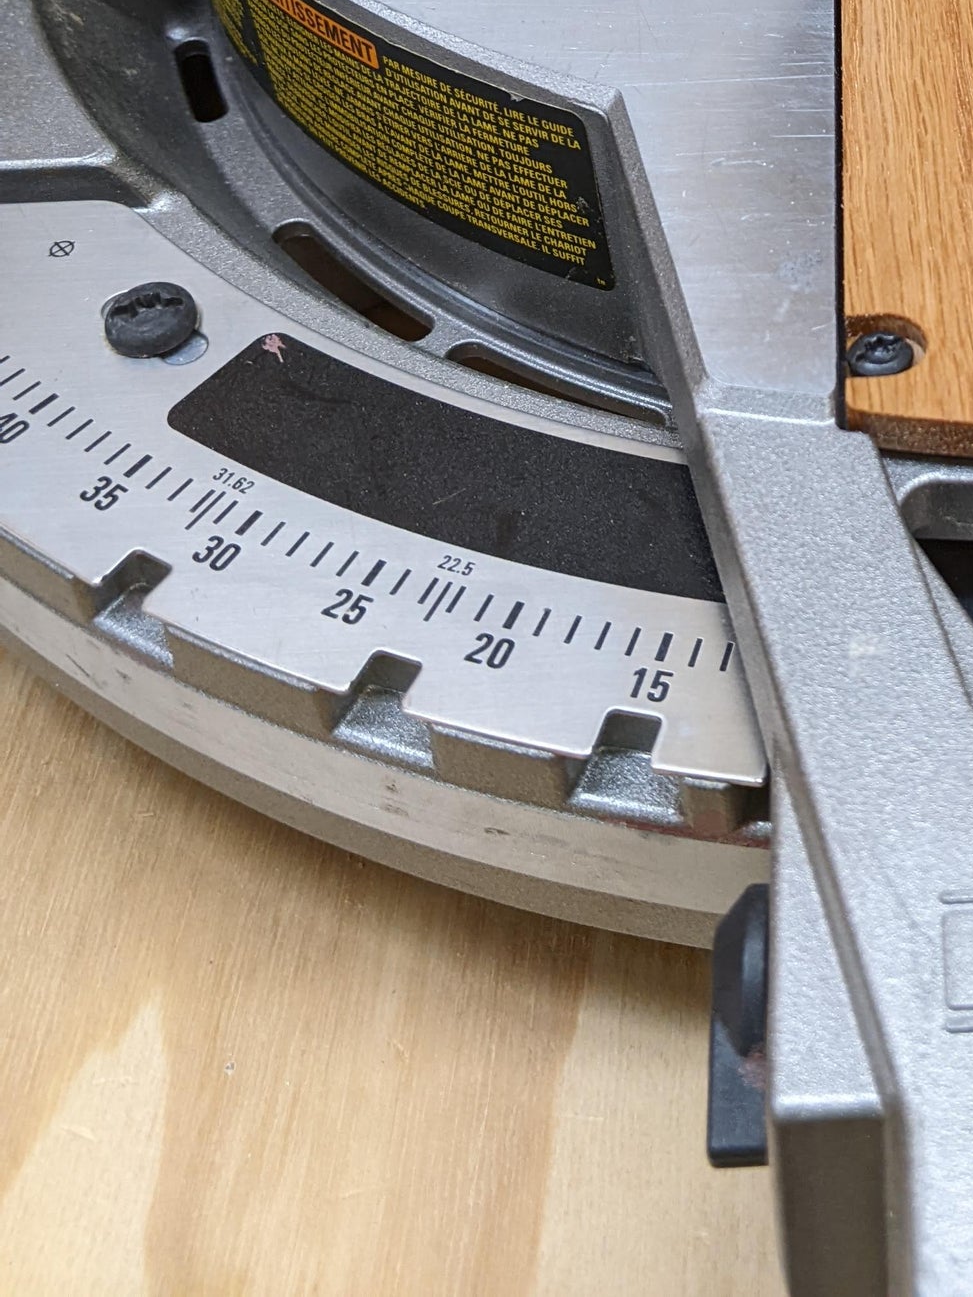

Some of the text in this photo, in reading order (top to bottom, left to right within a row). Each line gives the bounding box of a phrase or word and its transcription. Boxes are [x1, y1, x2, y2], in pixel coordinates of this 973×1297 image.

[382, 56, 400, 69] PAR
[401, 65, 438, 87] MESURE
[440, 83, 452, 93] DE
[503, 107, 525, 121] LIRE
[526, 115, 539, 126] LE
[541, 120, 574, 136] GUIDE
[384, 68, 581, 149] D'UTILISATION AVANT DE SE SERVIR DE LA
[384, 77, 440, 110] TRAJECTOIRE
[443, 107, 455, 116] DE
[457, 112, 470, 122] LA
[502, 130, 516, 140] NE
[518, 135, 539, 148] PAS
[401, 107, 436, 128] CHAQUE
[498, 149, 552, 173] TOUJOURS
[458, 123, 470, 132] LA
[472, 129, 530, 154] FERMETURE
[418, 145, 430, 154] DE
[431, 151, 443, 160] LA
[472, 170, 510, 189] METTRE
[512, 185, 548, 202] L'OUTIL
[550, 198, 577, 212] HORS
[434, 163, 446, 171] DE
[448, 169, 460, 178] LA
[461, 175, 487, 189] LAME
[489, 186, 520, 203] AVANT
[522, 198, 536, 209] DE
[476, 151, 490, 160] NE
[491, 156, 510, 169] PAS
[512, 164, 568, 188] EFFECTUER
[480, 163, 492, 172] DE
[494, 168, 506, 178] LA
[508, 173, 536, 188] LAME
[537, 183, 551, 193] DE
[553, 188, 566, 198] LA
[437, 183, 450, 192] LA
[450, 189, 475, 204] LAME
[476, 201, 490, 210] OU
[492, 207, 504, 217] DE
[506, 212, 532, 227] FAIRE
[534, 224, 596, 248] L'ENTRETIEN
[464, 186, 478, 195] OU
[478, 192, 491, 201] DE
[543, 216, 562, 228] SES
[436, 201, 466, 218] COUPE
[542, 246, 552, 254] IL
[552, 249, 584, 265] SUFFIT
[474, 209, 528, 234] RETOURNER
[530, 231, 542, 241] LE
[544, 236, 586, 255] CHARIOT
[80, 476, 129, 511] 35
[212, 468, 255, 494] 31.62
[192, 535, 242, 571] 30
[437, 555, 476, 576] 22.5
[321, 589, 374, 624] 25
[464, 633, 515, 669] 20
[630, 667, 674, 702] 15
